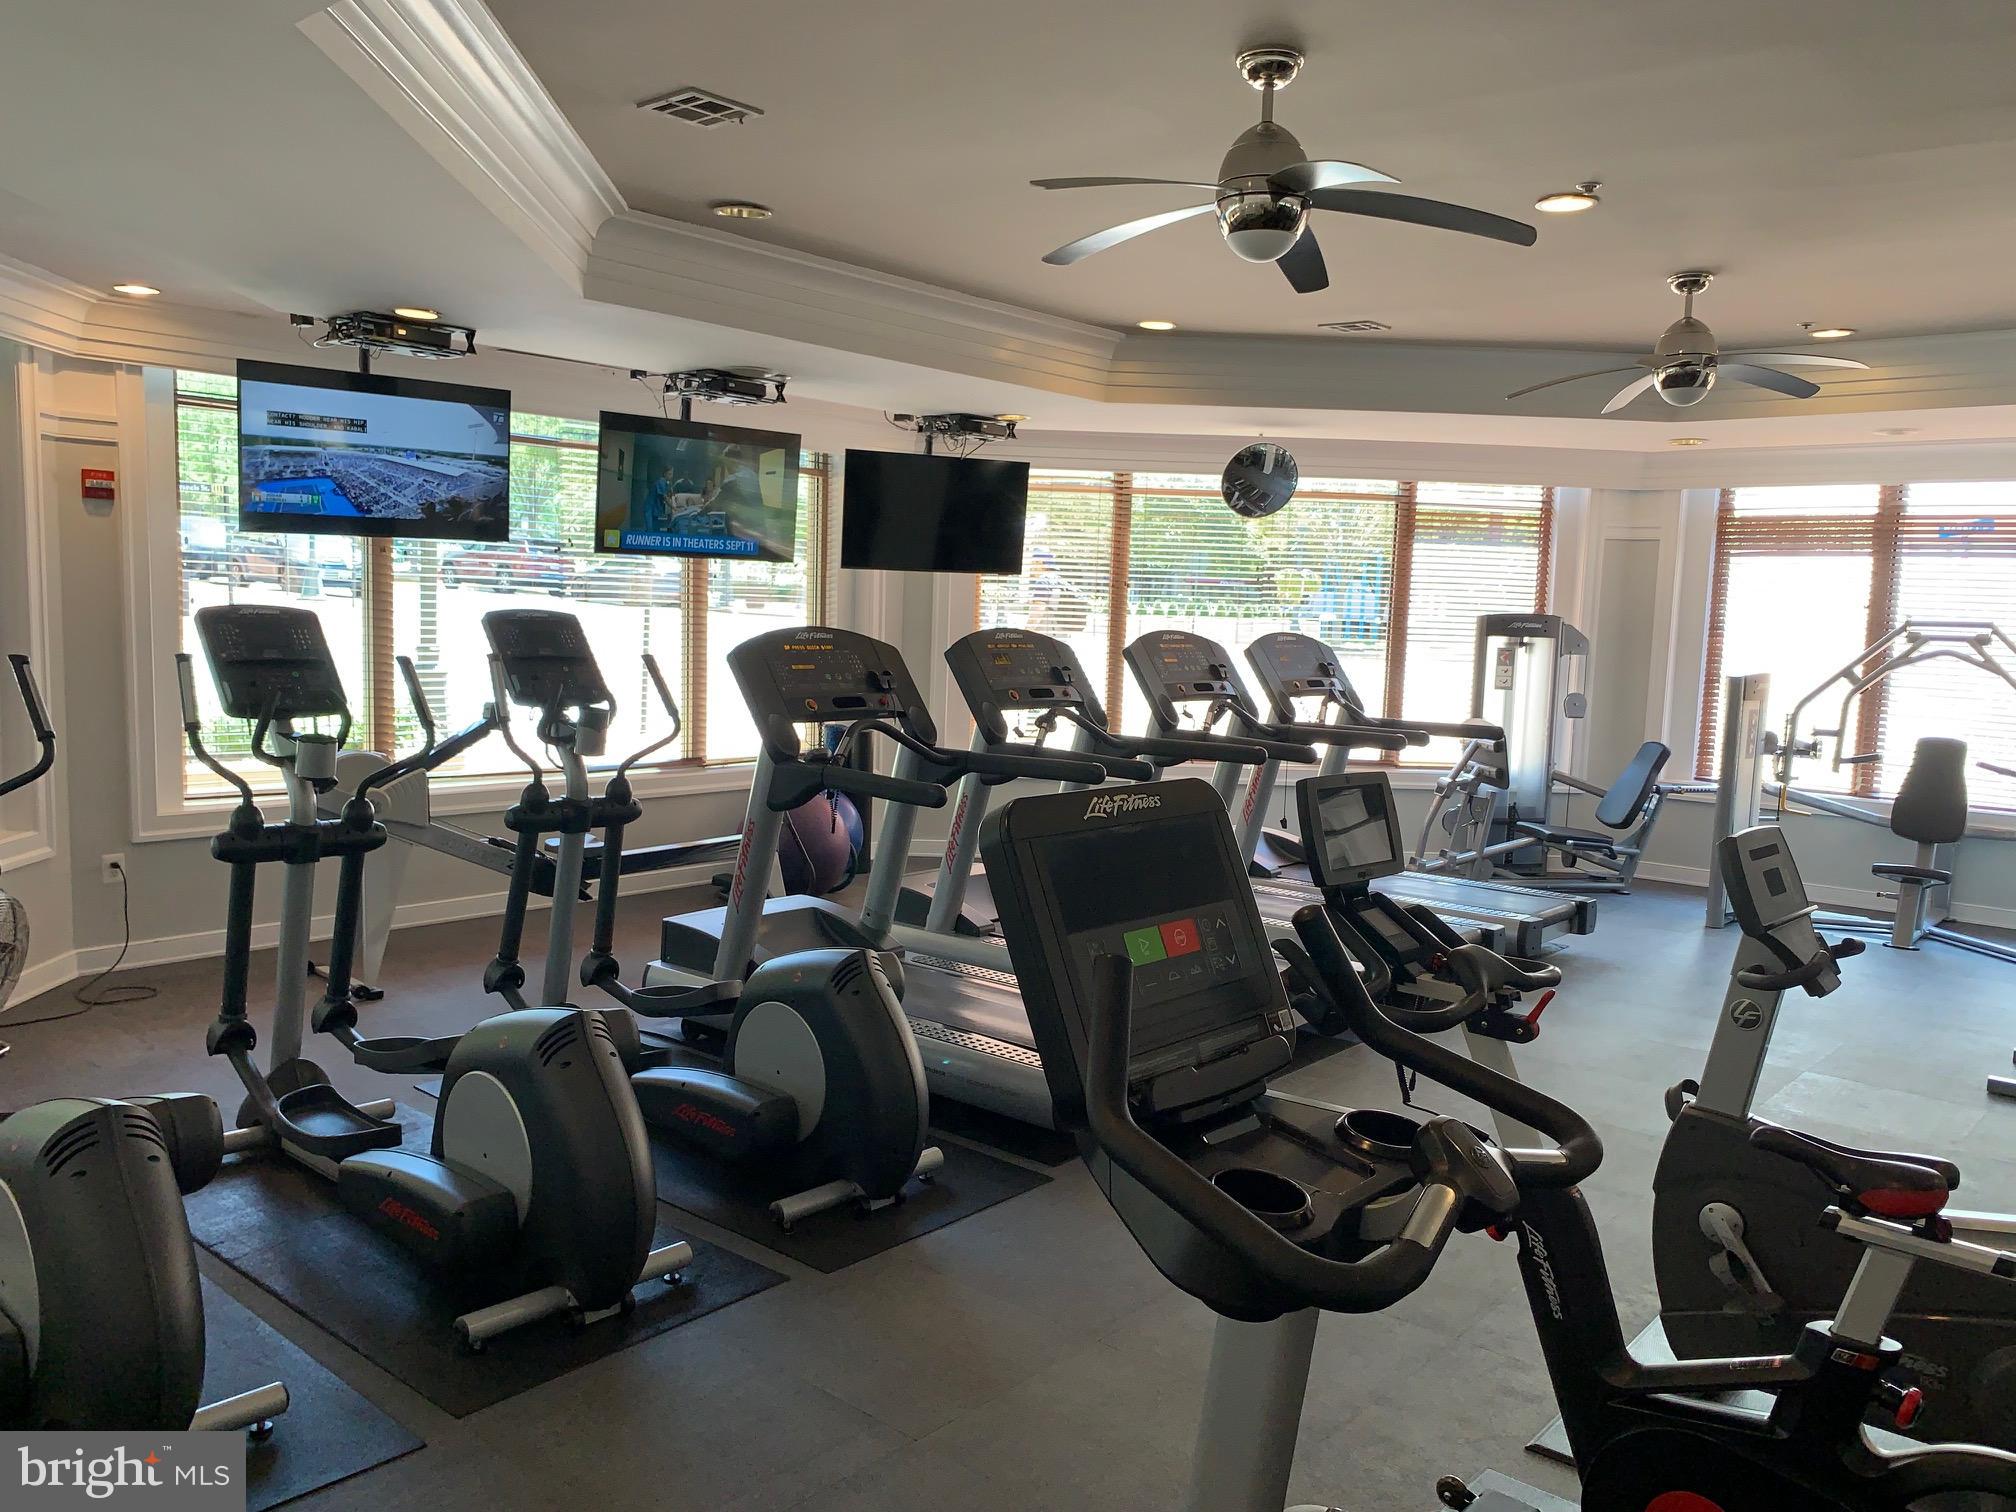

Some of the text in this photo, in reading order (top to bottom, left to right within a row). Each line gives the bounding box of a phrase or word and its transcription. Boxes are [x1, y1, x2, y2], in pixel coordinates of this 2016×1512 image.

[625, 533, 754, 551] RUNNER IS IN THEATERS SEPT 11
